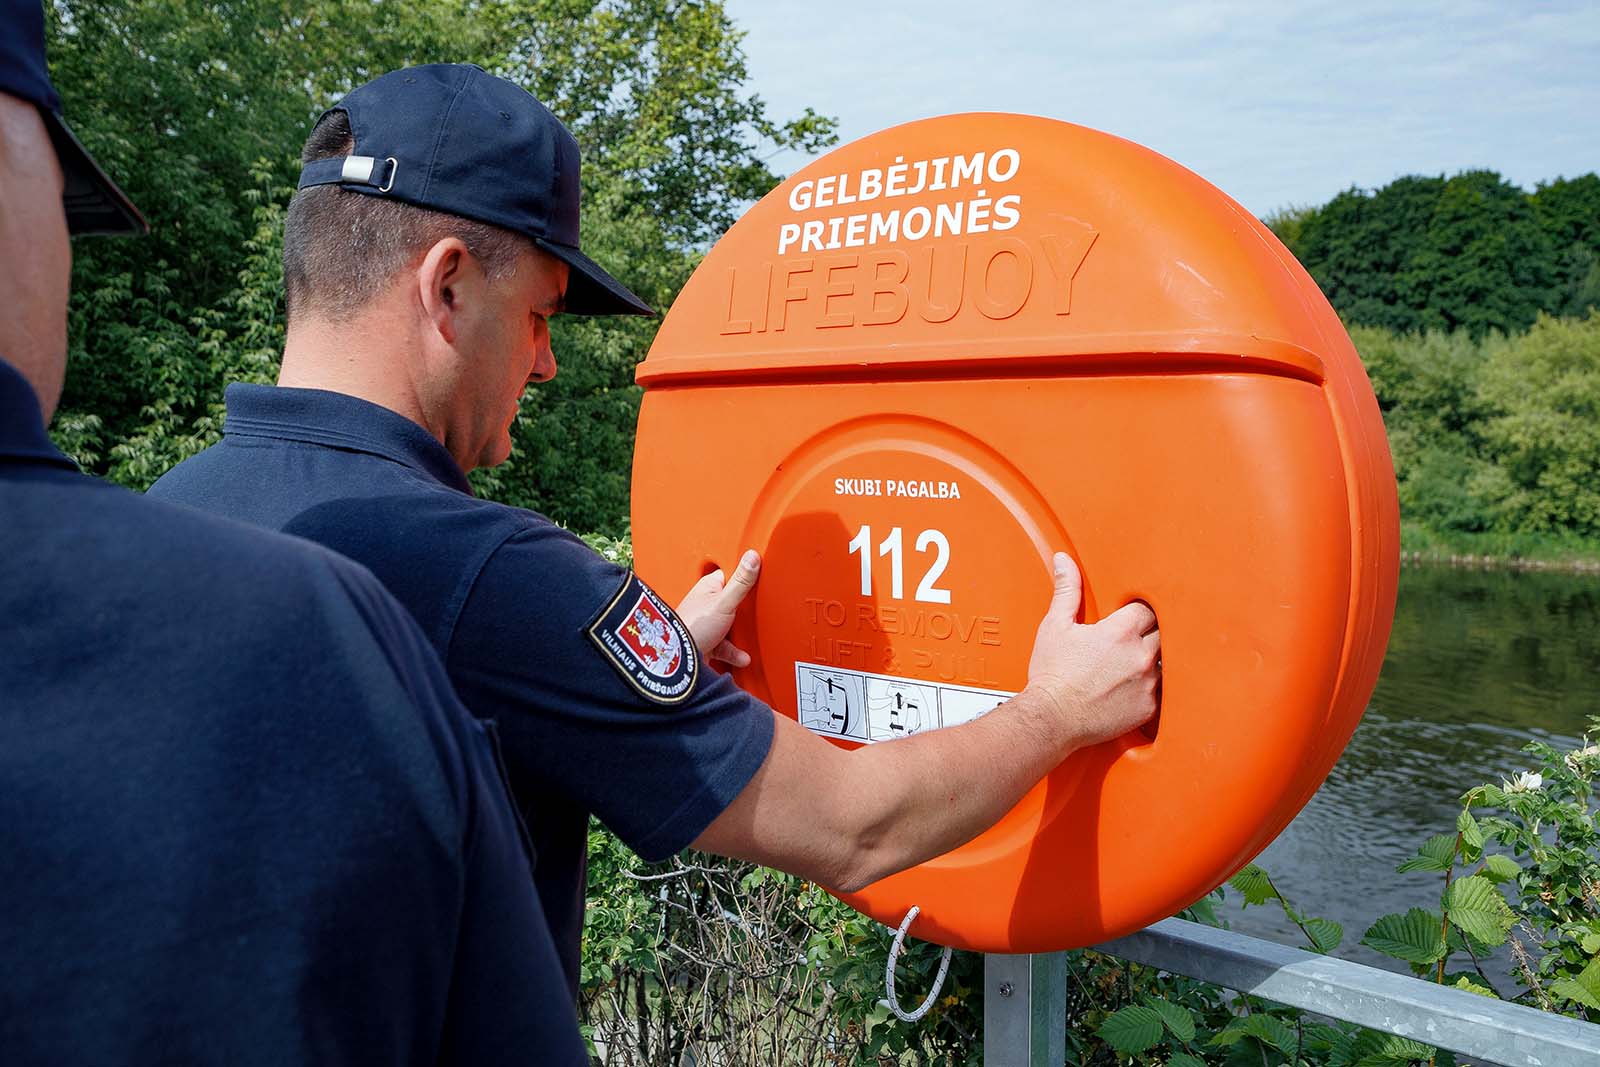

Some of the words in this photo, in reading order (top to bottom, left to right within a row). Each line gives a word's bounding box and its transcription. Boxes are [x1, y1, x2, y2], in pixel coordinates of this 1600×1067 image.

[789, 148, 1020, 212] GELBĖJIMO
[777, 190, 1021, 255] PRIEMONĖS
[720, 231, 1100, 335] LIFEBUOY
[834, 478, 882, 496] SKUBI
[886, 479, 961, 499] PAGALBA
[849, 525, 951, 604] 112
[602, 629, 637, 671] VILNIAUS
[806, 598, 846, 628] TO
[856, 603, 1001, 646] REMOVE
[810, 634, 873, 669] LIFT
[912, 647, 1000, 687] PULL
